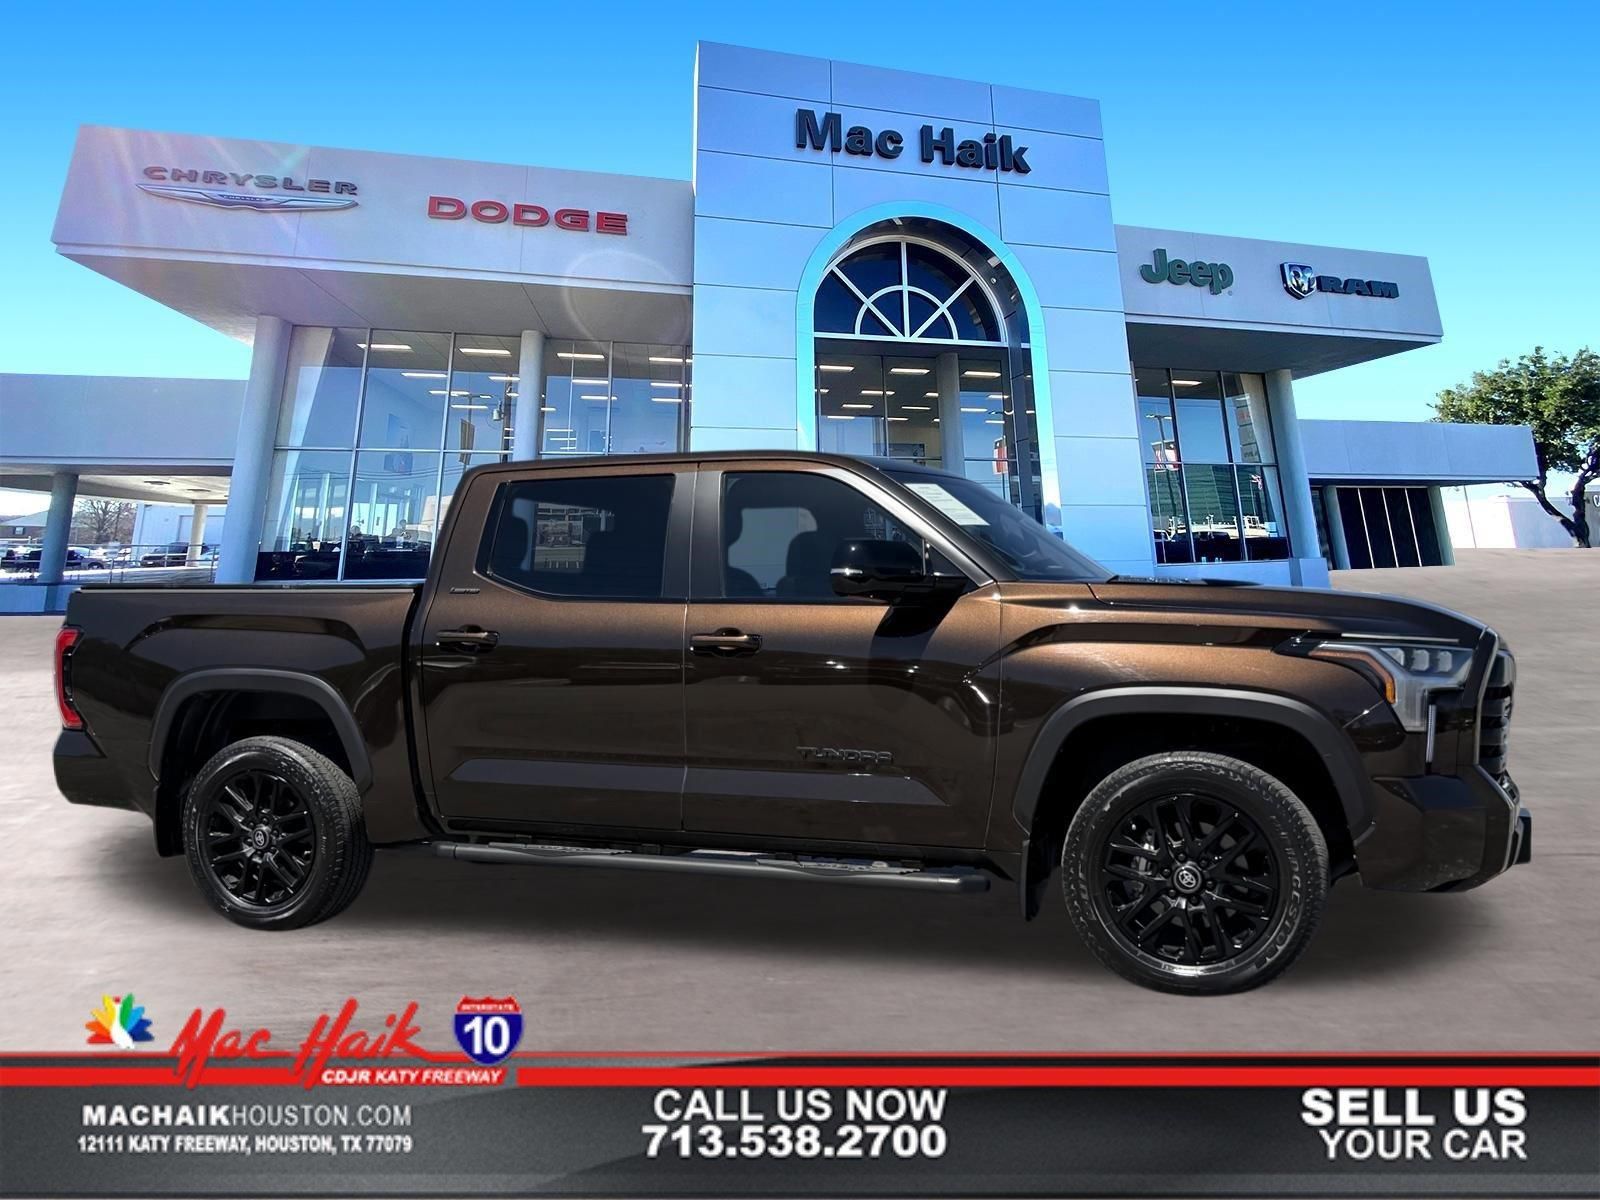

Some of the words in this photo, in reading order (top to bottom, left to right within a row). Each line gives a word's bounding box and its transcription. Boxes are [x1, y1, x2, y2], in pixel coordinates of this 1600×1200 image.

[795, 108, 904, 159] Mac
[919, 124, 1032, 174] Haik
[143, 166, 358, 196] CHRYSLER
[428, 196, 628, 236] DODGE
[1139, 248, 1234, 295] Jeep
[1315, 275, 1400, 299] RAM
[796, 746, 893, 764] TUNDRA
